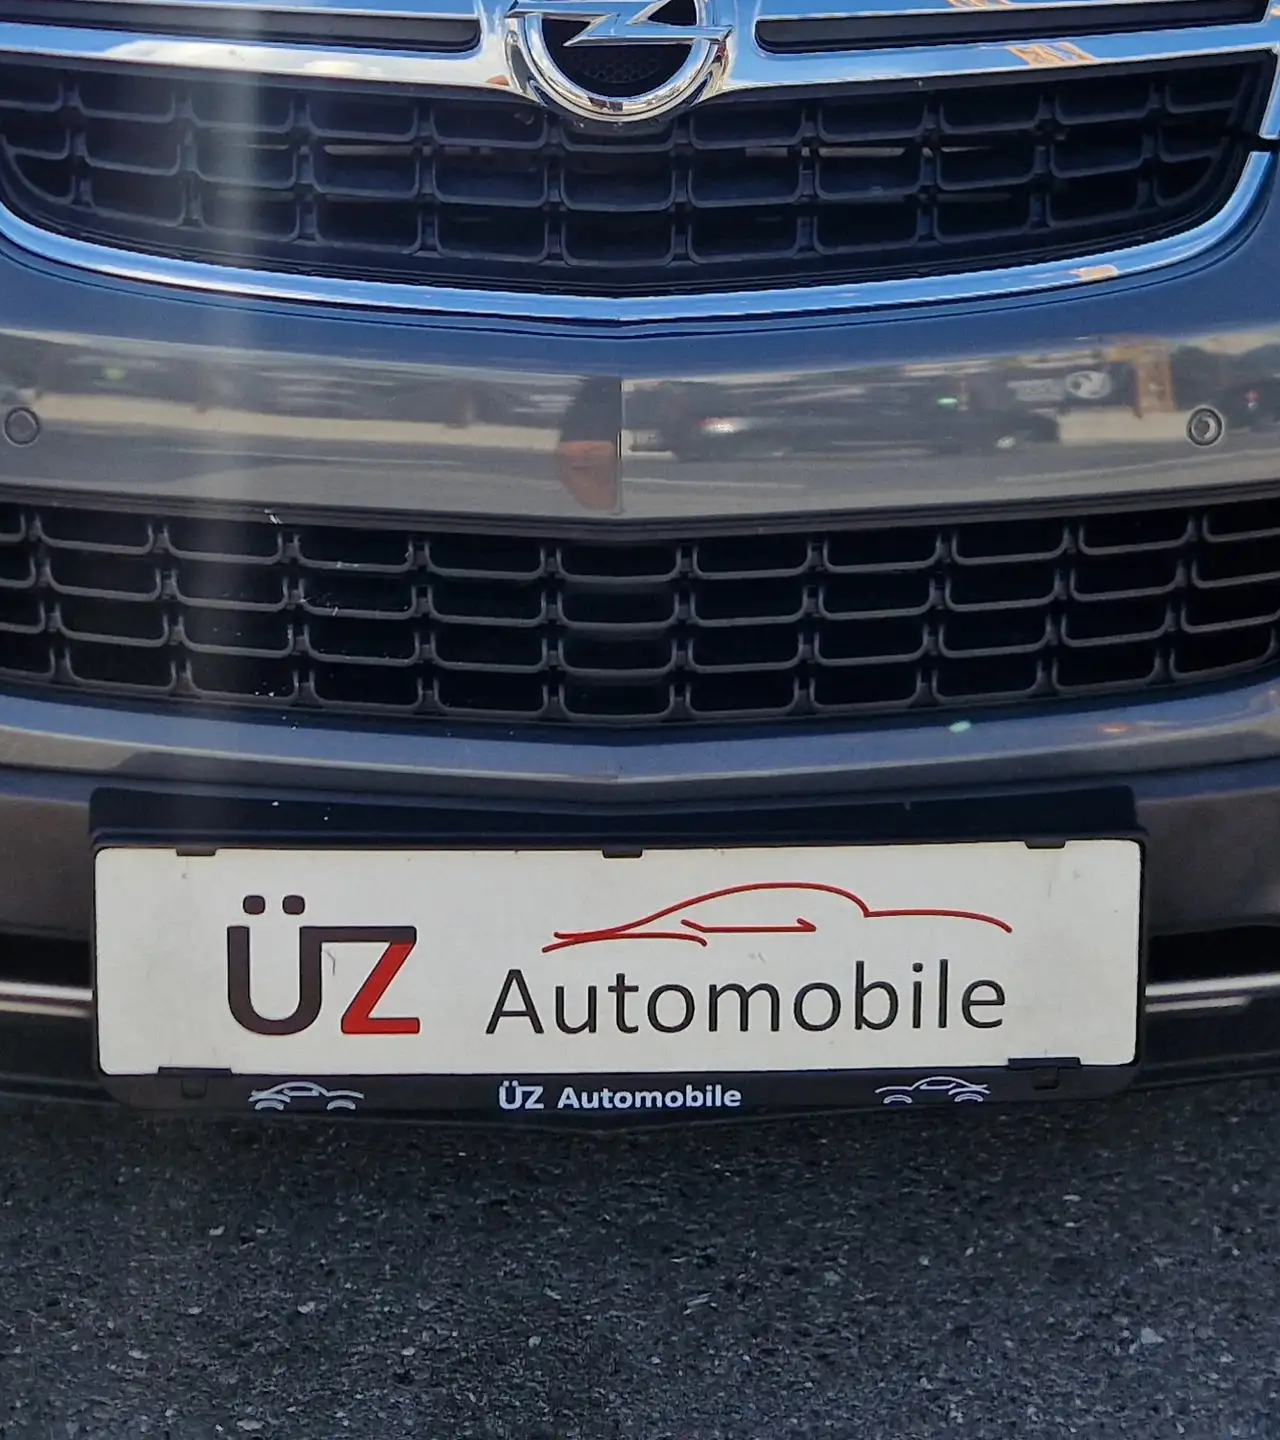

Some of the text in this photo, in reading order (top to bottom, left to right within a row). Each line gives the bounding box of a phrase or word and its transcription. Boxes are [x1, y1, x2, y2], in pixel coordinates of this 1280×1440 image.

[226, 893, 1009, 1038] ÜZ Automobile
[497, 1079, 743, 1110] ÜZ Automobile
